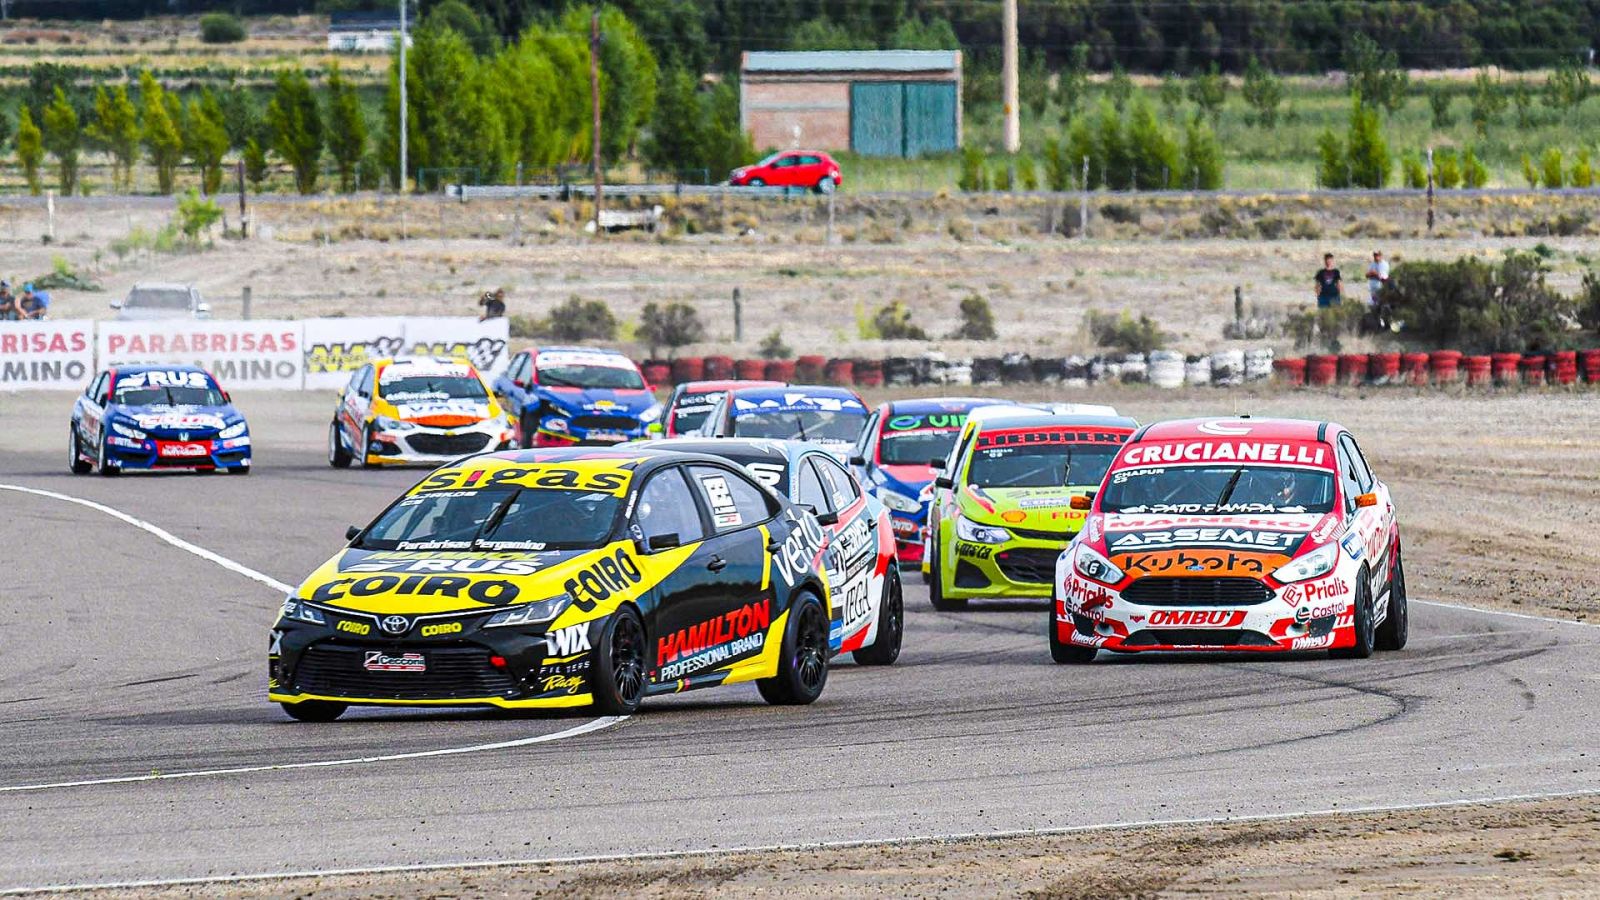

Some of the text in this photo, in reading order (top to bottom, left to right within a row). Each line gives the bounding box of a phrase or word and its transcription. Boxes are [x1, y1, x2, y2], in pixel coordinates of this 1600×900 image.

[0, 332, 87, 353] RISAS
[107, 332, 296, 354] PARABRISAS
[2, 360, 87, 382] MINO
[148, 371, 209, 387] RUS
[1123, 442, 1325, 464] CRUCIANELLI
[1109, 517, 1311, 529] MAINERO
[396, 539, 547, 551] Parabrisas Pergamino
[1111, 529, 1305, 547] ARSEMET
[405, 560, 545, 575] RUS
[1125, 552, 1264, 573] Kubota
[311, 575, 521, 605] COIRO
[564, 547, 642, 613] COIRO
[1304, 578, 1349, 602] Prialis
[1148, 610, 1227, 626] OMBU
[1312, 601, 1346, 619] Castrol
[421, 621, 463, 637] COIRO
[656, 599, 771, 668] HAMILTON
[660, 631, 764, 682] PROFESSIONAL BRAND
[539, 661, 591, 674] FILTERS
